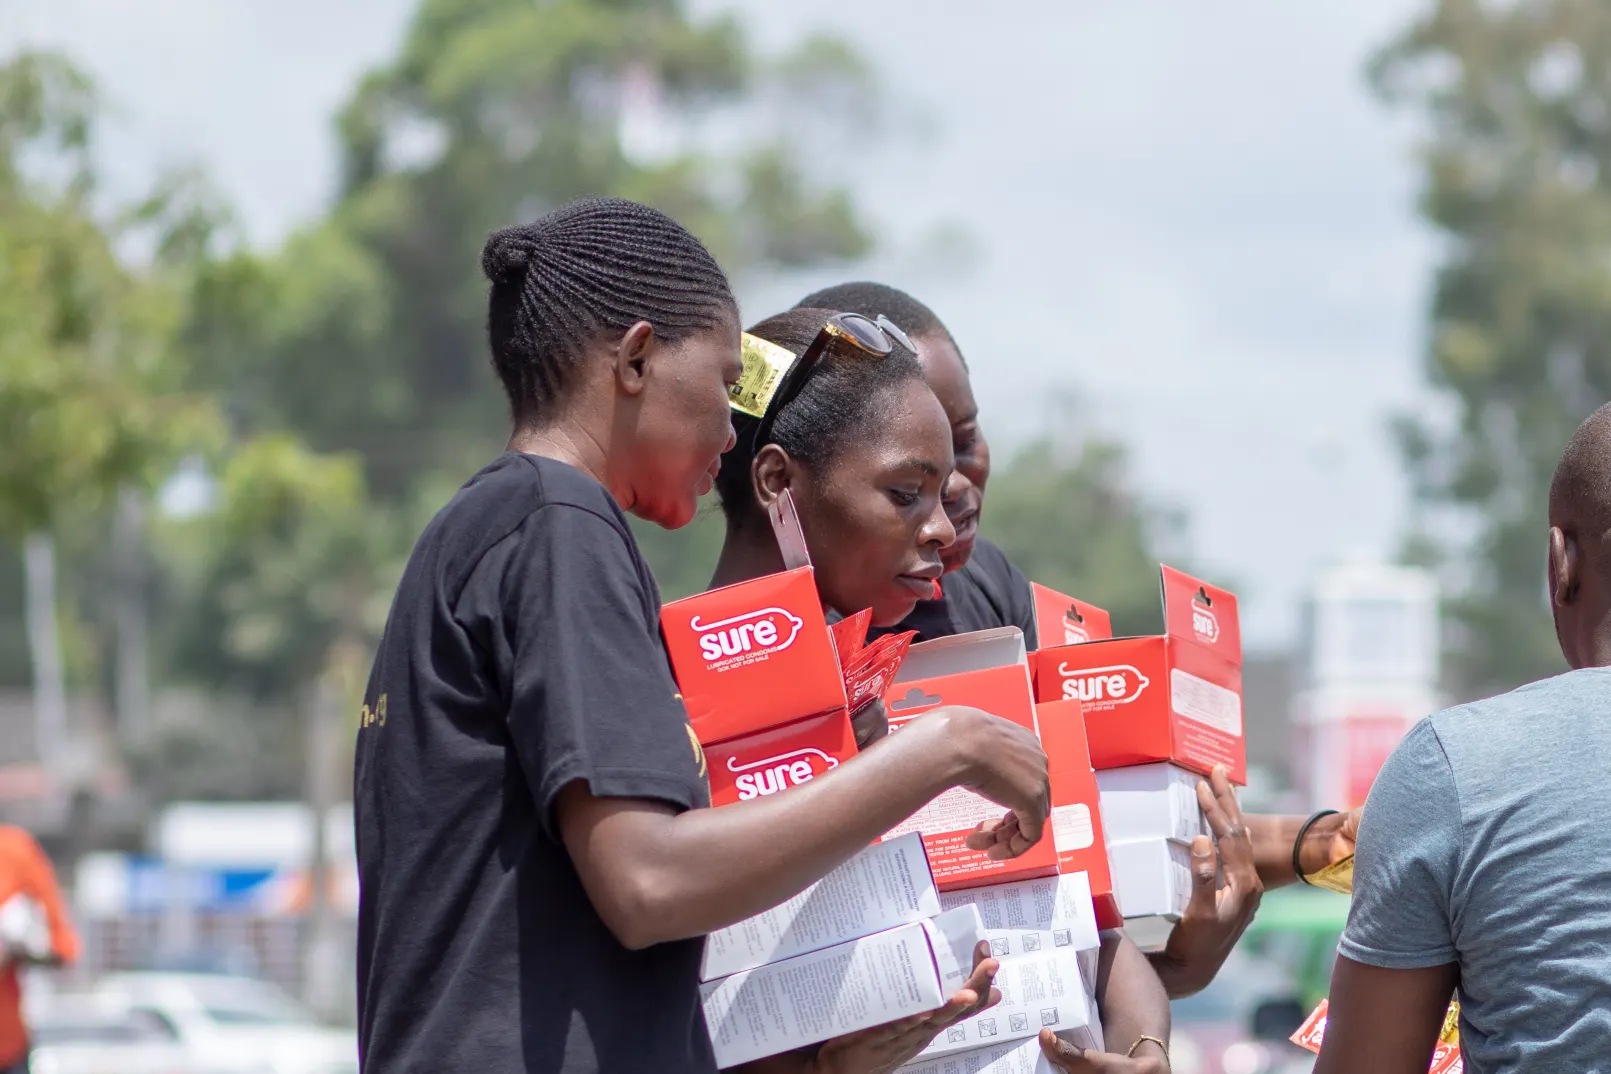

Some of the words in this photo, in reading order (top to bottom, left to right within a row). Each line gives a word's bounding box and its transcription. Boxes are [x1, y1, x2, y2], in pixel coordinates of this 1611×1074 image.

[700, 620, 778, 661] sure
[707, 655, 744, 670] LUBRICATED
[745, 646, 777, 660] CONDOMS
[730, 661, 742, 669] NOT
[743, 658, 754, 666] FOR
[755, 654, 769, 662] SALE
[1062, 674, 1126, 701] sure
[735, 760, 814, 801] sure
